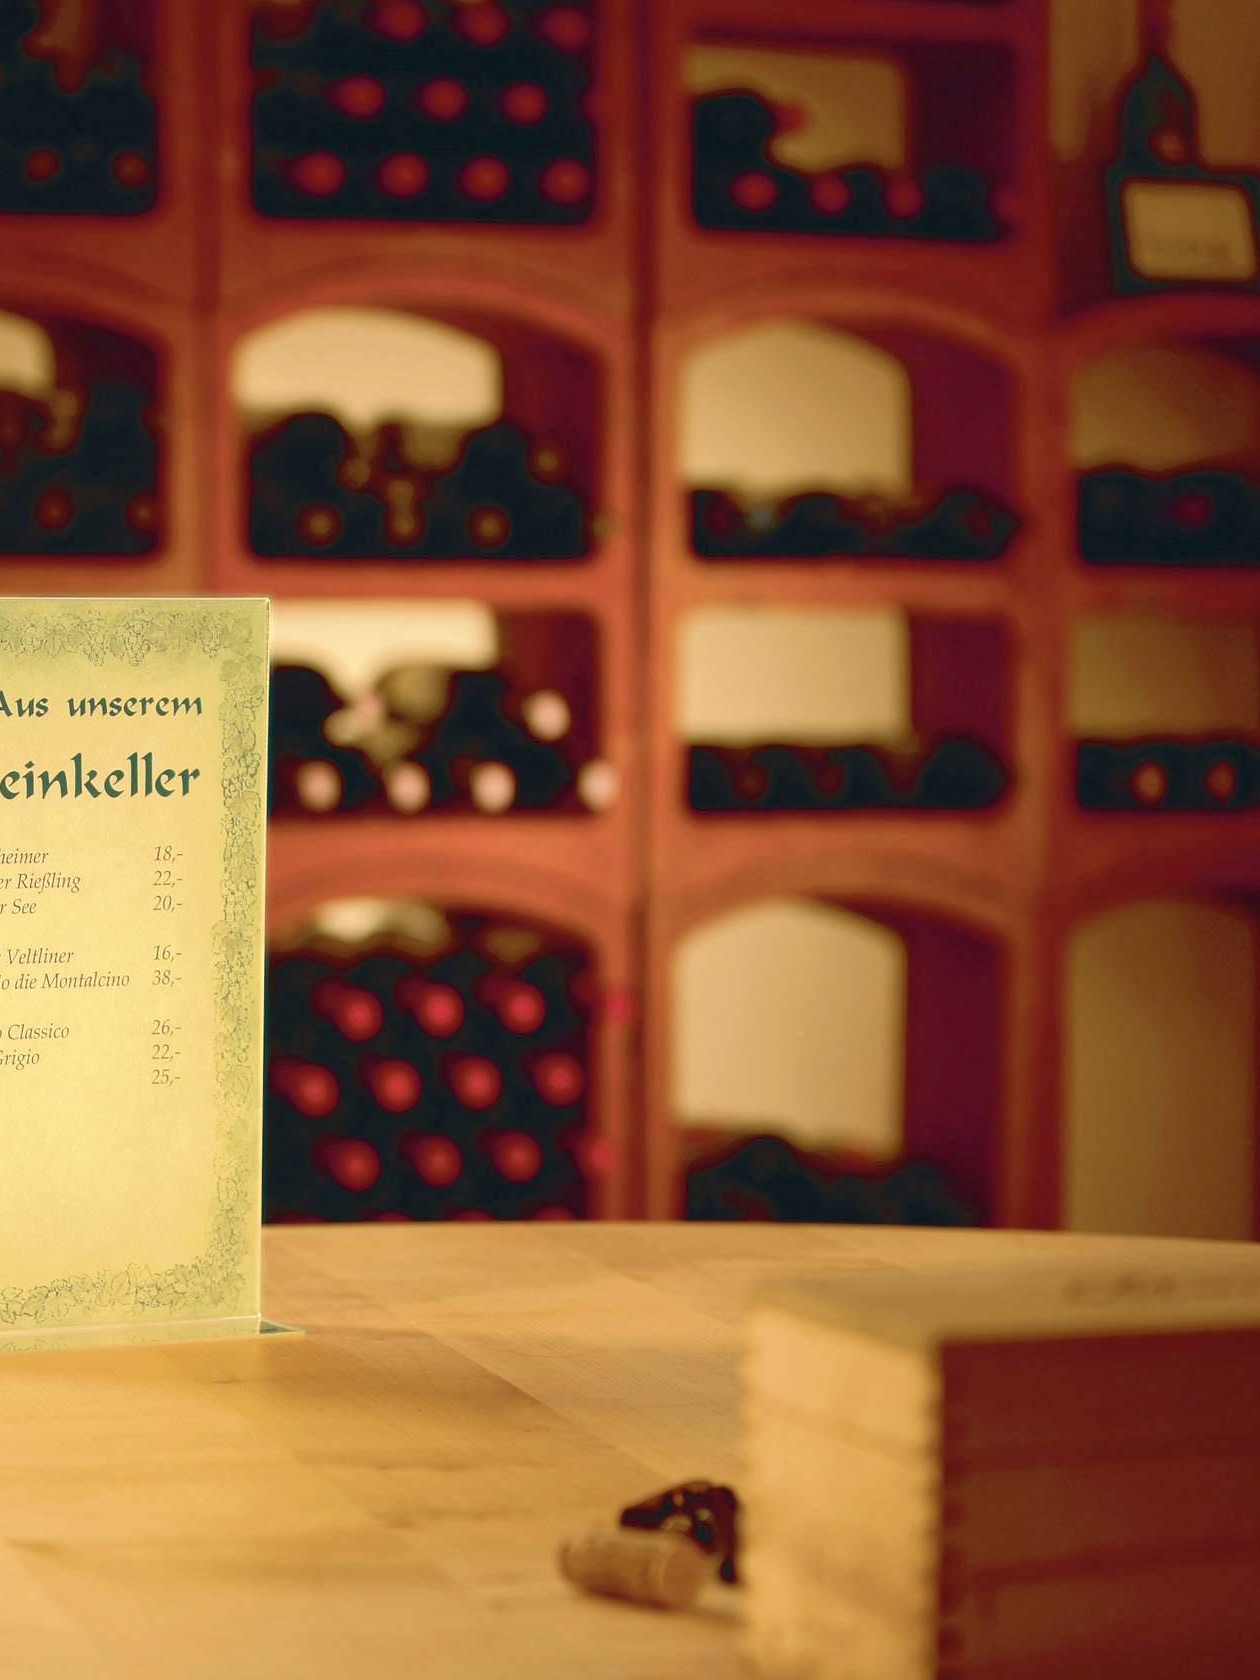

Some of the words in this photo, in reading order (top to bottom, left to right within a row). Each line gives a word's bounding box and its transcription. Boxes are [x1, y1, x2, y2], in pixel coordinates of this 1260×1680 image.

[67, 693, 203, 718] unserem
[153, 846, 184, 863] 18,-
[17, 872, 82, 894] Rießling
[153, 870, 183, 888] 22,-
[12, 899, 37, 915] See
[152, 895, 183, 913] 20,-
[8, 948, 74, 966] Veltliner
[152, 944, 182, 962] 16,-
[14, 973, 38, 991] die
[41, 971, 130, 989] Montalcino
[152, 969, 182, 987] 38,-
[8, 1023, 70, 1041] Classico
[152, 1019, 182, 1037] 26,-
[152, 1044, 181, 1062] 22,-
[152, 1069, 181, 1087] 25,-
